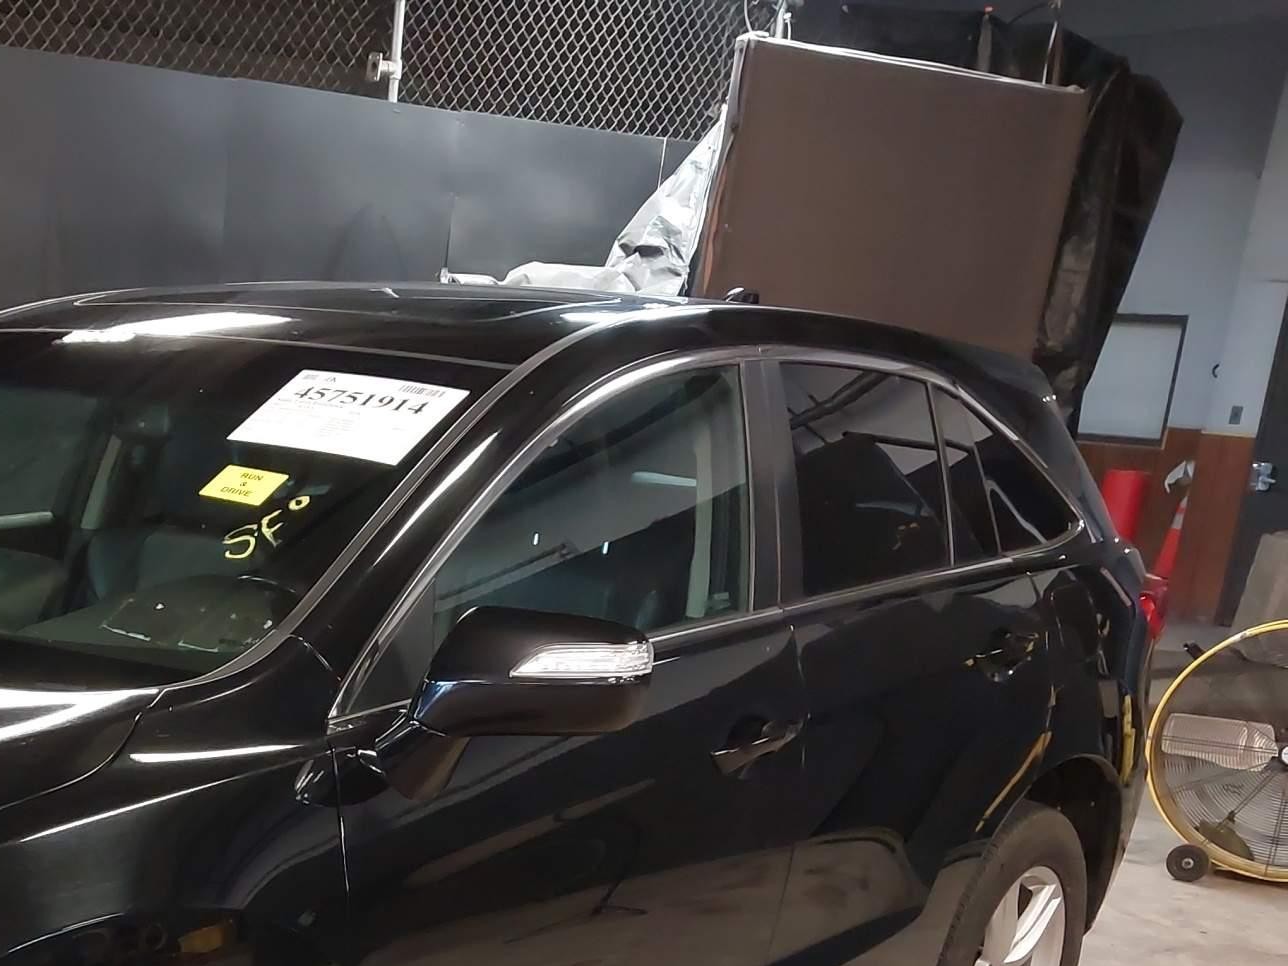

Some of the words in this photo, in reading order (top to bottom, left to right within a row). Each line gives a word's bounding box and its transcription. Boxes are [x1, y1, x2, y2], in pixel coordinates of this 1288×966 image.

[294, 386, 430, 415] 45751914
[240, 472, 264, 481] RUN
[220, 486, 253, 497] DRIVE
